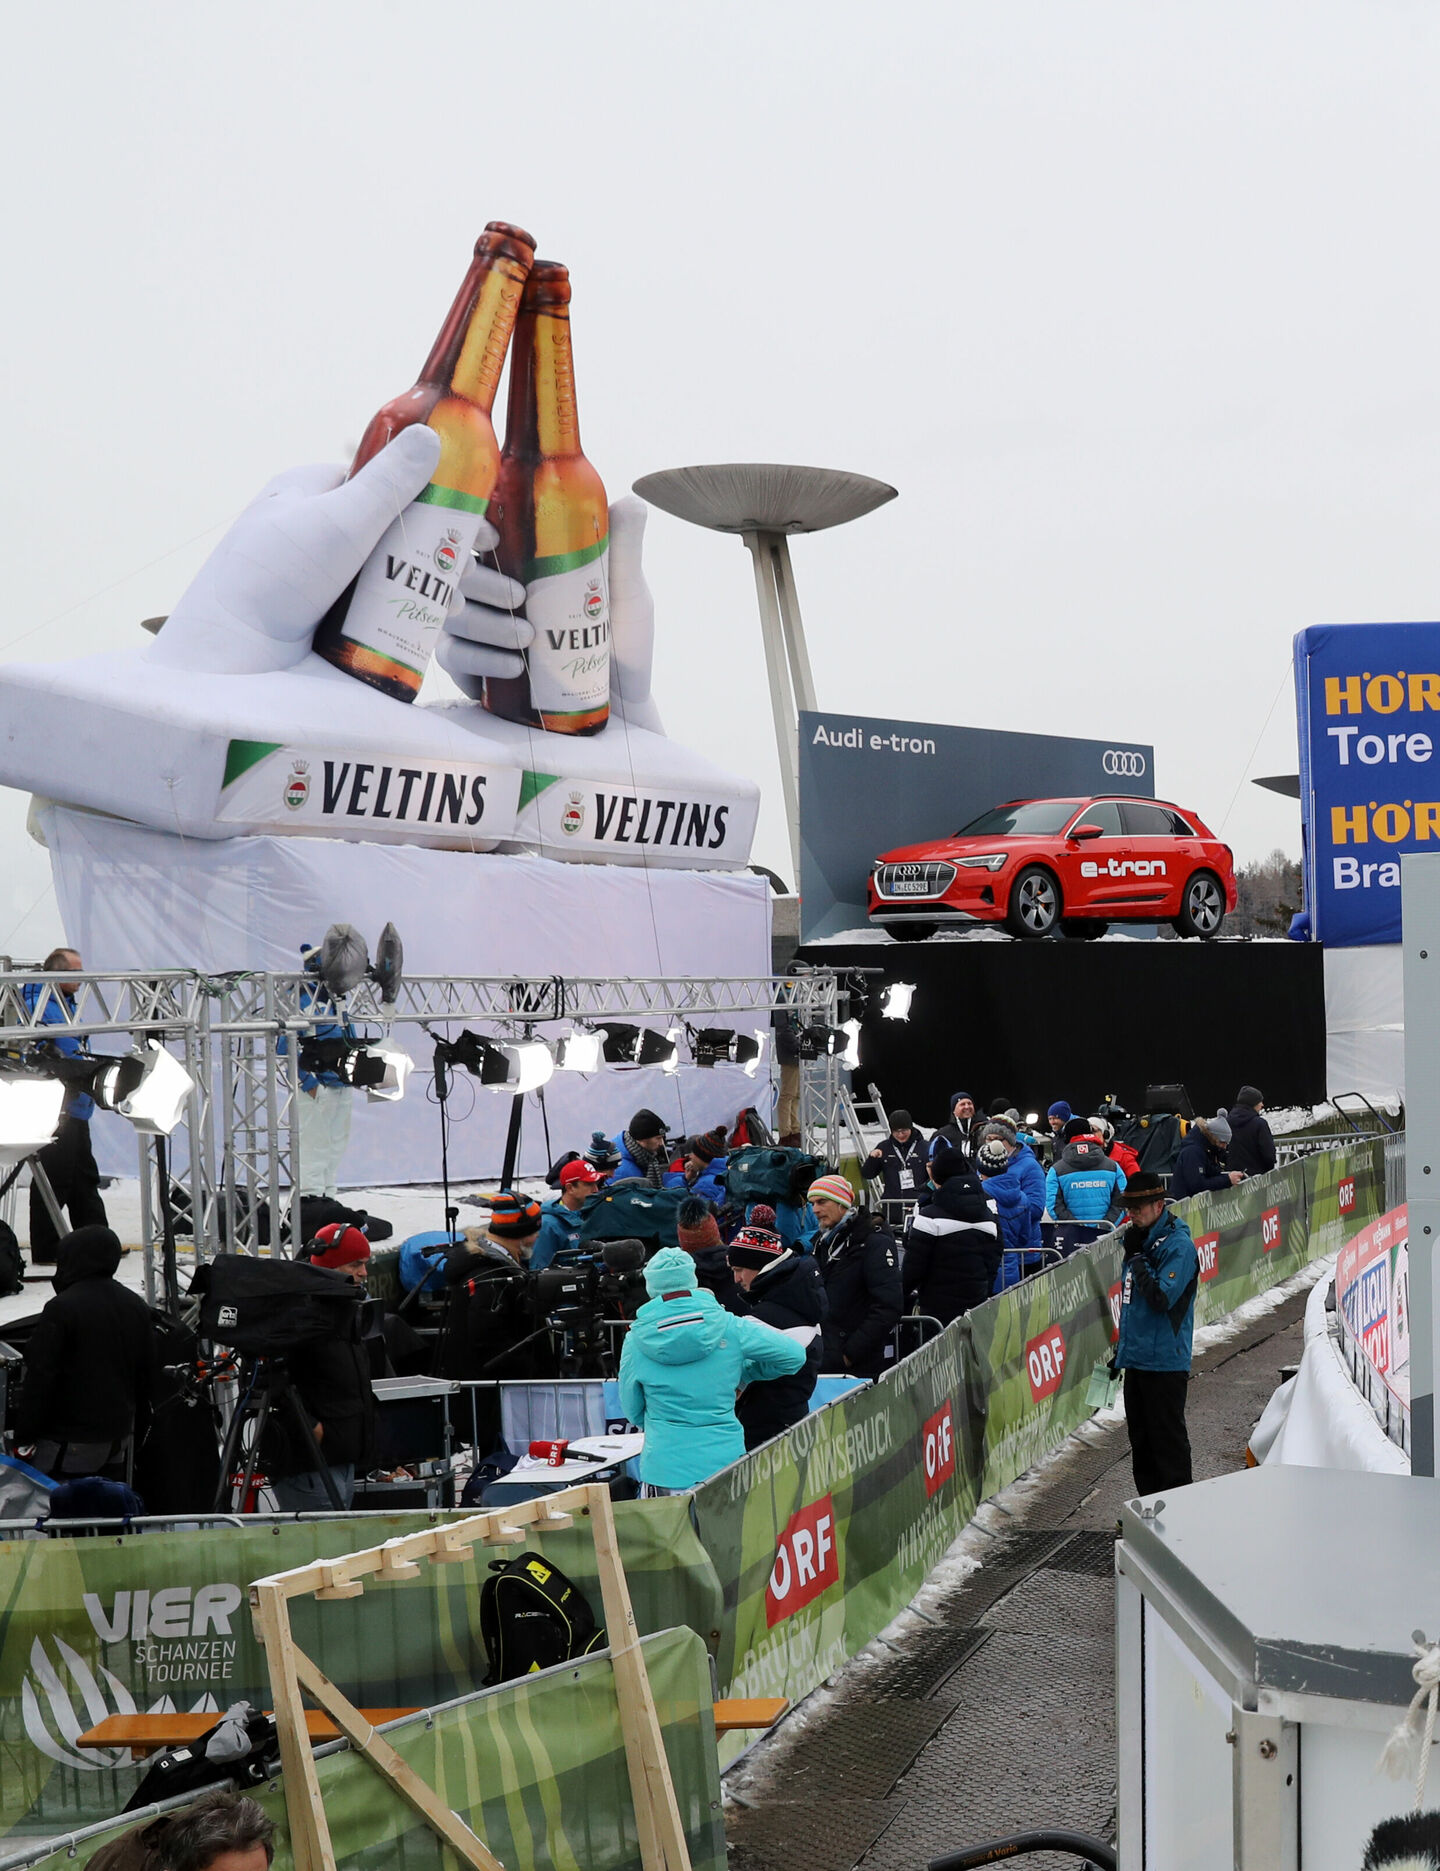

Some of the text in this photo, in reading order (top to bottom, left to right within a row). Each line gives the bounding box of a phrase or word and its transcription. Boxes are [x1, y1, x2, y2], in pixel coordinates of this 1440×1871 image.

[812, 724, 936, 756] Audi e-tron
[1327, 725, 1433, 765] Tore
[322, 760, 487, 826] VELTINS
[594, 793, 729, 850] VELTINS
[1080, 857, 1167, 878] e-tron
[1028, 1336, 1065, 1389] ORF
[806, 1406, 894, 1497] INNSBRUCK
[769, 1513, 831, 1601] ORF
[82, 1583, 242, 1643] VIER
[134, 1640, 237, 1664] SCHANZEN
[147, 1661, 234, 1683] TOURNEE
